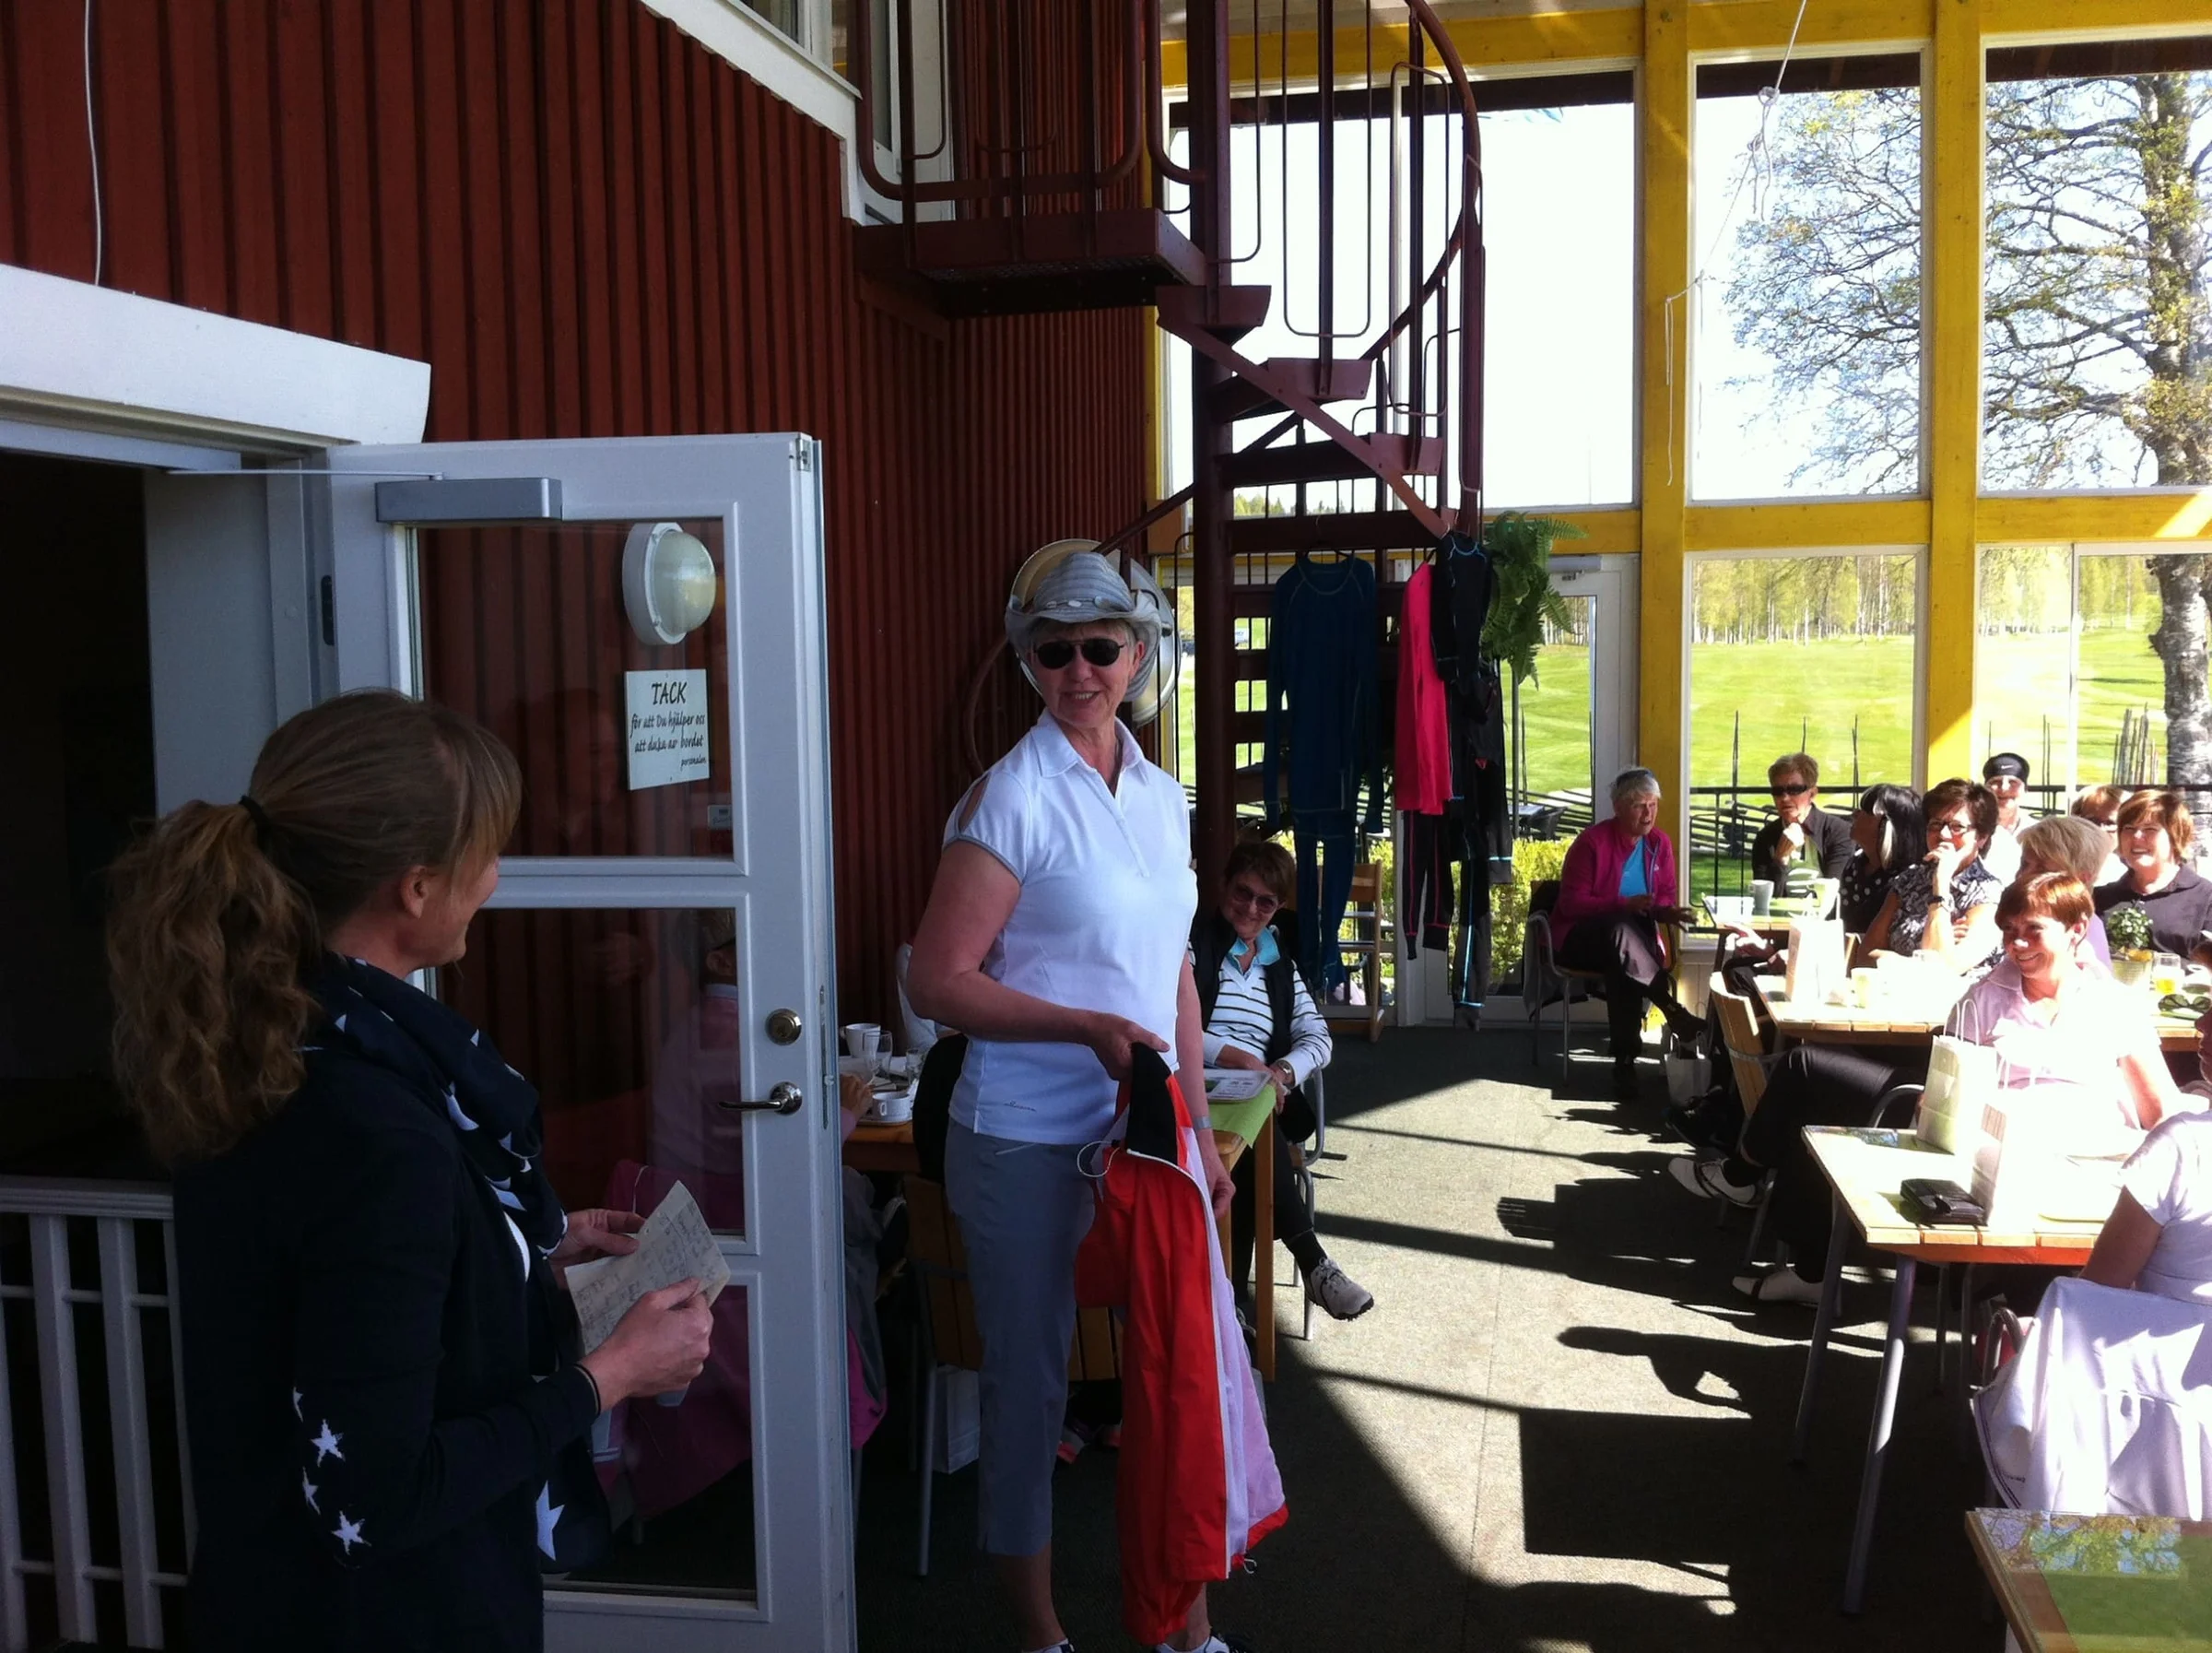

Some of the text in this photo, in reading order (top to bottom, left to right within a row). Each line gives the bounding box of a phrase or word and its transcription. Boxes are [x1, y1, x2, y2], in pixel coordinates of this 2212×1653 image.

[652, 681, 688, 704] TACK
[629, 711, 705, 738] för att Du hjälper oss
[635, 733, 703, 752] att duka av bordet
